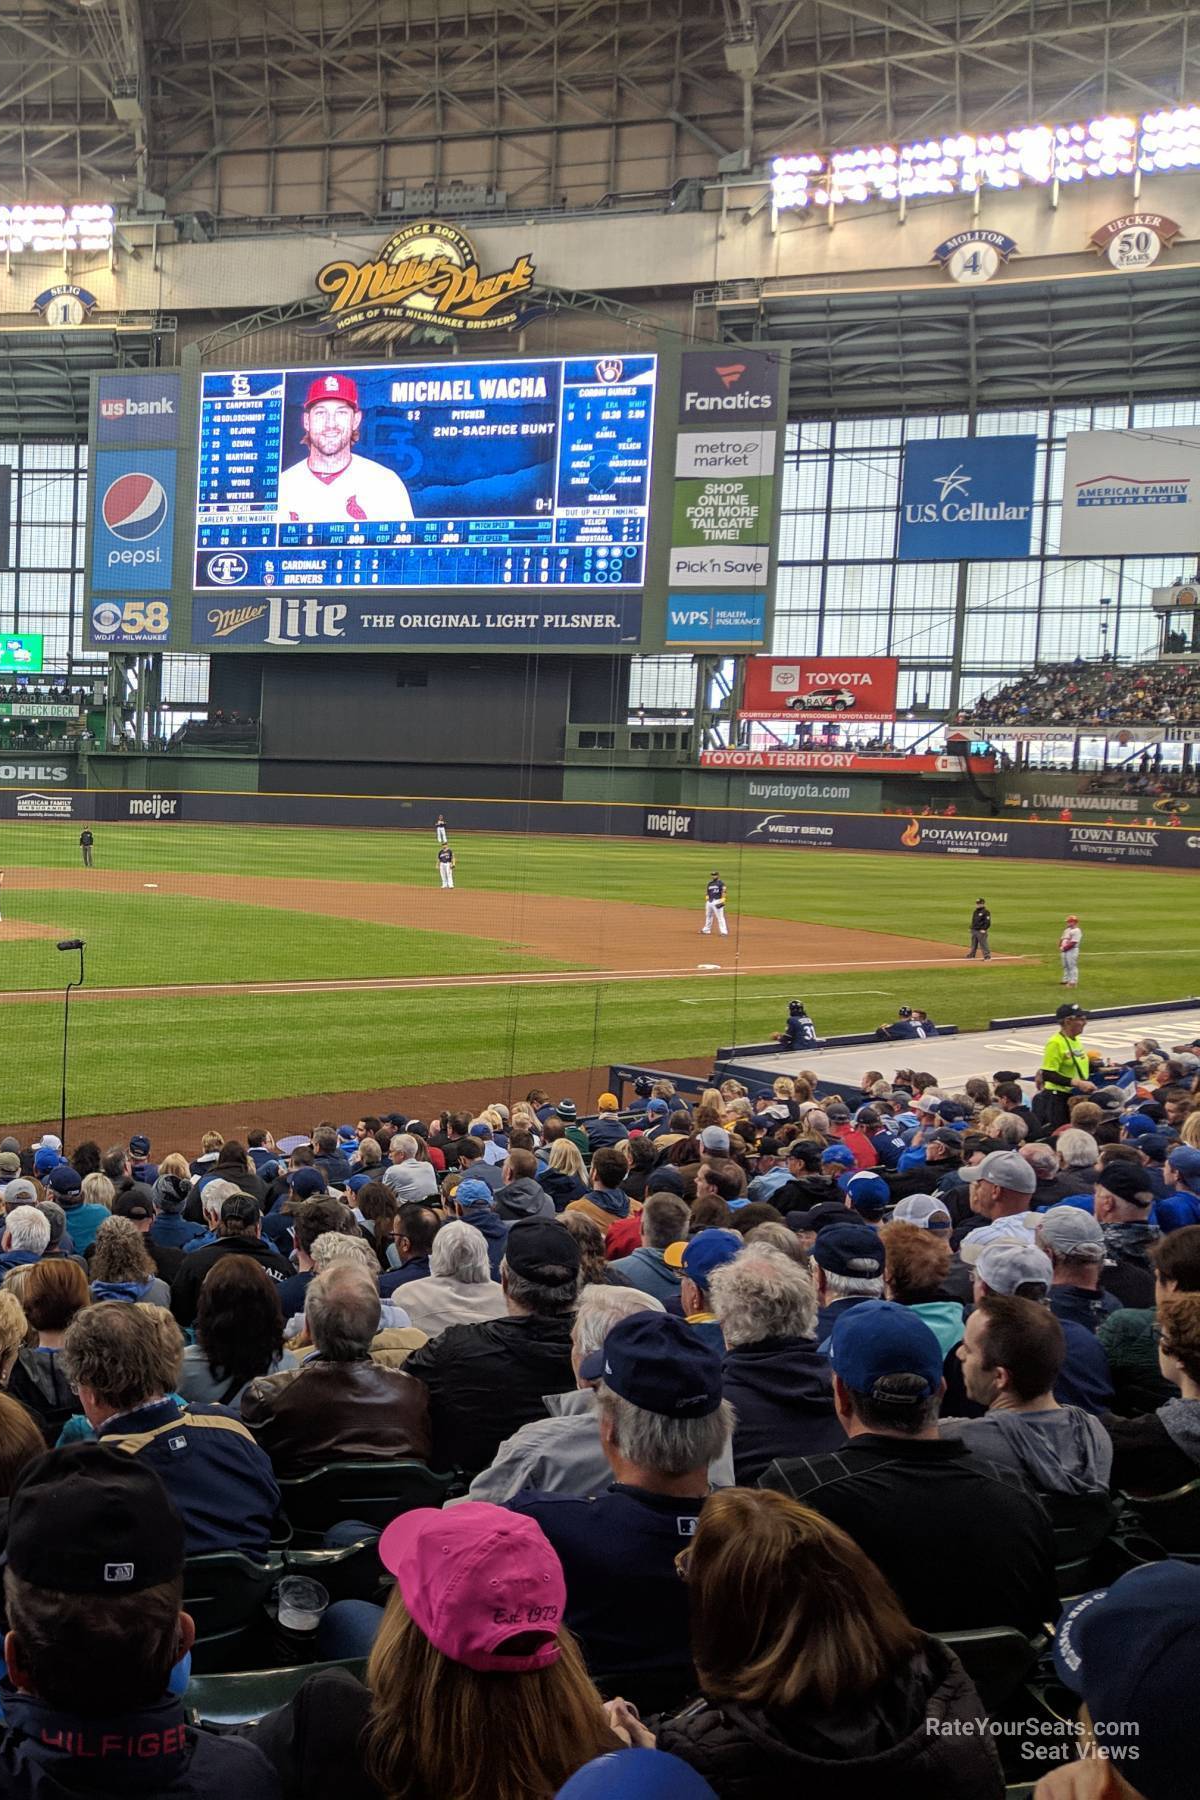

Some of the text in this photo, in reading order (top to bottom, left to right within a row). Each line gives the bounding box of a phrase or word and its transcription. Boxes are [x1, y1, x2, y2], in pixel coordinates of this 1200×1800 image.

[1107, 214, 1162, 233] UECKER
[393, 225, 460, 247] SINCE 2001
[947, 233, 1005, 250] MOLITOR
[1119, 231, 1152, 255] 50
[963, 251, 981, 275] 4
[50, 285, 81, 297] SELIG
[317, 253, 536, 317] Miller Park
[59, 304, 71, 324] 1
[336, 307, 518, 330] HOME OF THE MILWAUKEE BREWERS
[391, 377, 547, 403] MICHAEL WACHA
[226, 401, 263, 410] CARPENTER
[685, 391, 772, 411] Fanatics
[433, 423, 556, 437] 2ND-SACIFICE BUNT
[695, 442, 742, 454] metro
[694, 454, 749, 467] market
[228, 466, 254, 474] FOWLER
[704, 483, 744, 494] SHOP
[1078, 485, 1188, 497] AMERICAN FAMILY
[226, 492, 254, 500] WIETERS
[698, 494, 749, 506] ONLINE
[1085, 496, 1180, 505] INSURANCE
[226, 515, 234, 523] VS
[237, 514, 275, 522] MILWAUKEE
[686, 506, 759, 518] FOR MORE
[905, 501, 1030, 523] U.S. Cellular
[690, 518, 754, 529] TAILGATE
[703, 529, 740, 540] TIME!
[108, 547, 161, 567] pepsi
[281, 560, 327, 570] CARDINALS
[724, 561, 763, 573] Save
[284, 573, 323, 584] BREWERS
[121, 601, 170, 634] 58
[208, 597, 621, 645] Miller Lite THE ORIGINAL LIGHT PILSNER.
[671, 611, 708, 625] WPS
[806, 673, 872, 686] TOYOTA
[807, 698, 832, 706] RAV4
[19, 705, 49, 716] CHECK
[51, 706, 74, 717] DECK
[703, 751, 855, 768] TOYOTA TERRITORY
[750, 782, 850, 800] buyatoyota.com
[129, 794, 177, 819] meijer
[647, 810, 691, 836] meijer
[768, 825, 834, 836] WEST BEND
[921, 829, 1008, 842] POTAWATOMI
[1069, 829, 1161, 847] TOWN BANK
[1080, 845, 1127, 855] WINTRUST
[1128, 848, 1152, 856] BANK
[803, 1025, 817, 1041] 31
[527, 1605, 558, 1623] 1979
